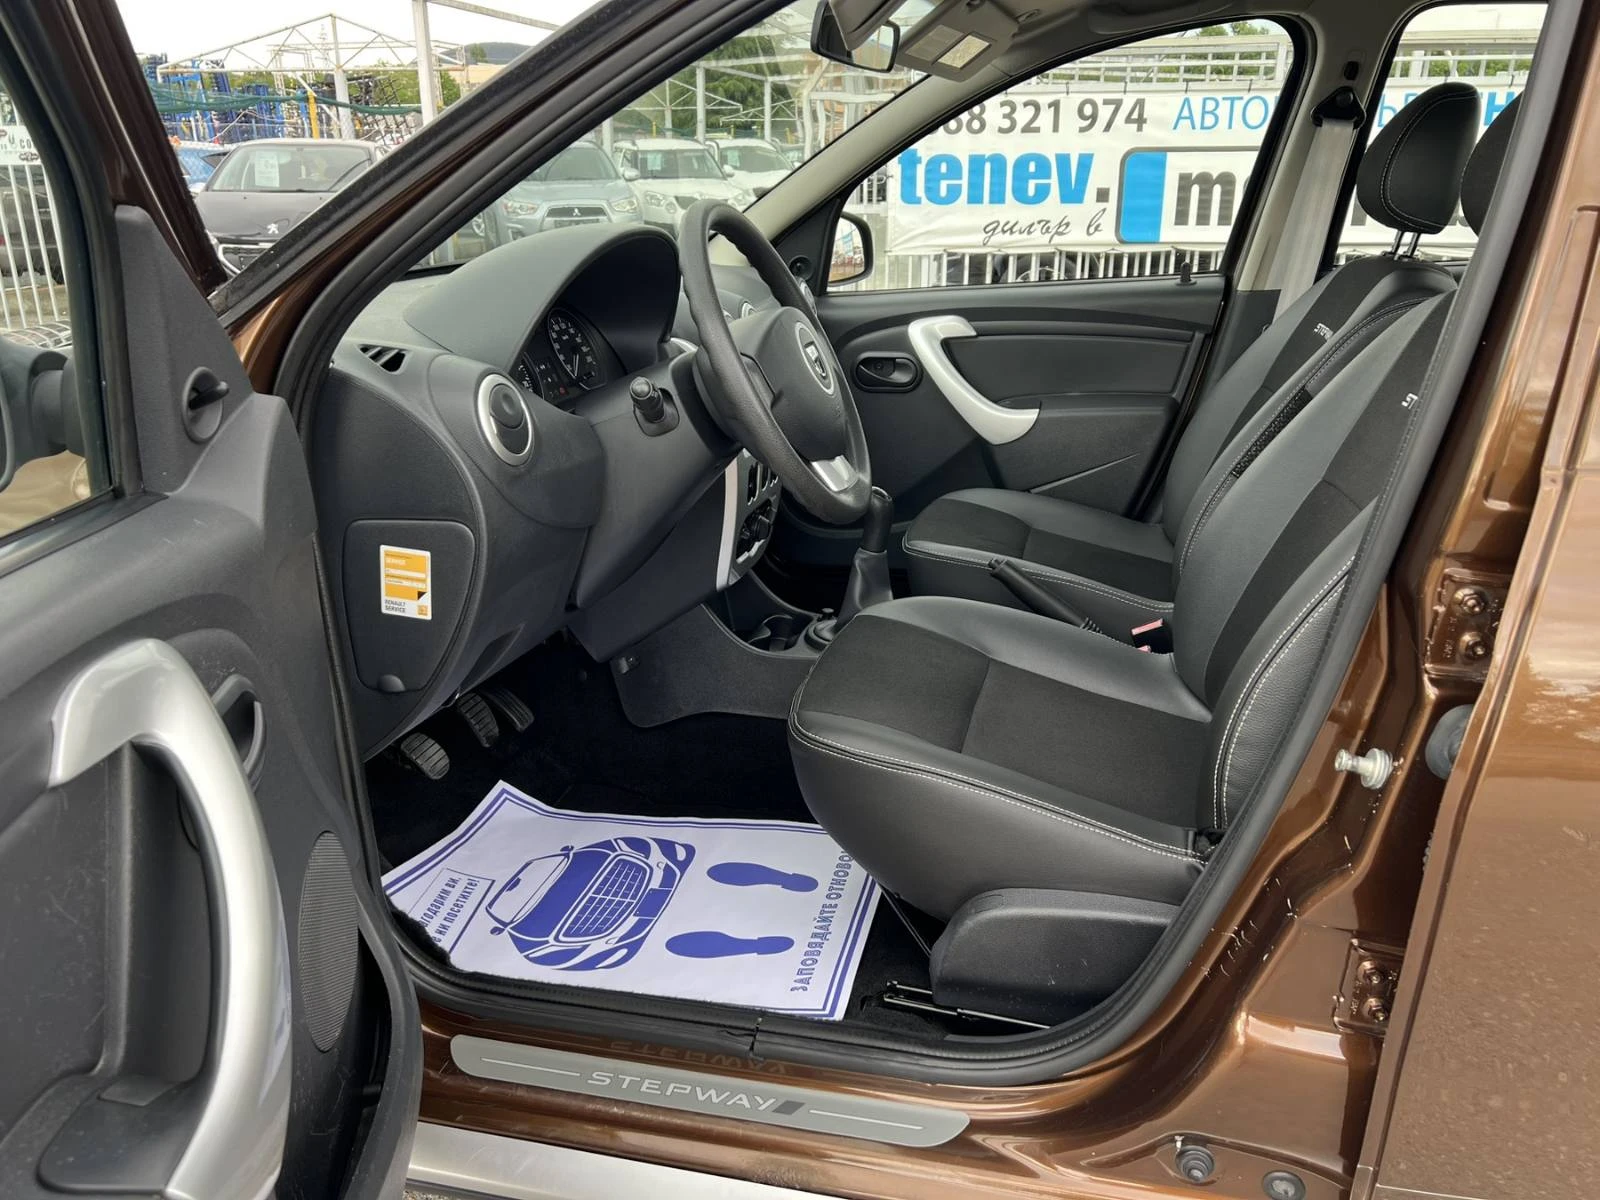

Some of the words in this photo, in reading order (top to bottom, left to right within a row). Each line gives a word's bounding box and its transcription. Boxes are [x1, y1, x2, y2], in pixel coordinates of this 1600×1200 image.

[997, 98, 1061, 134] 321
[1077, 97, 1148, 133] 974
[1173, 94, 1281, 130] АВТО
[790, 903, 838, 992] ЗАПОВЯДАЙТЕ
[587, 1071, 777, 1112] STEPWAY
